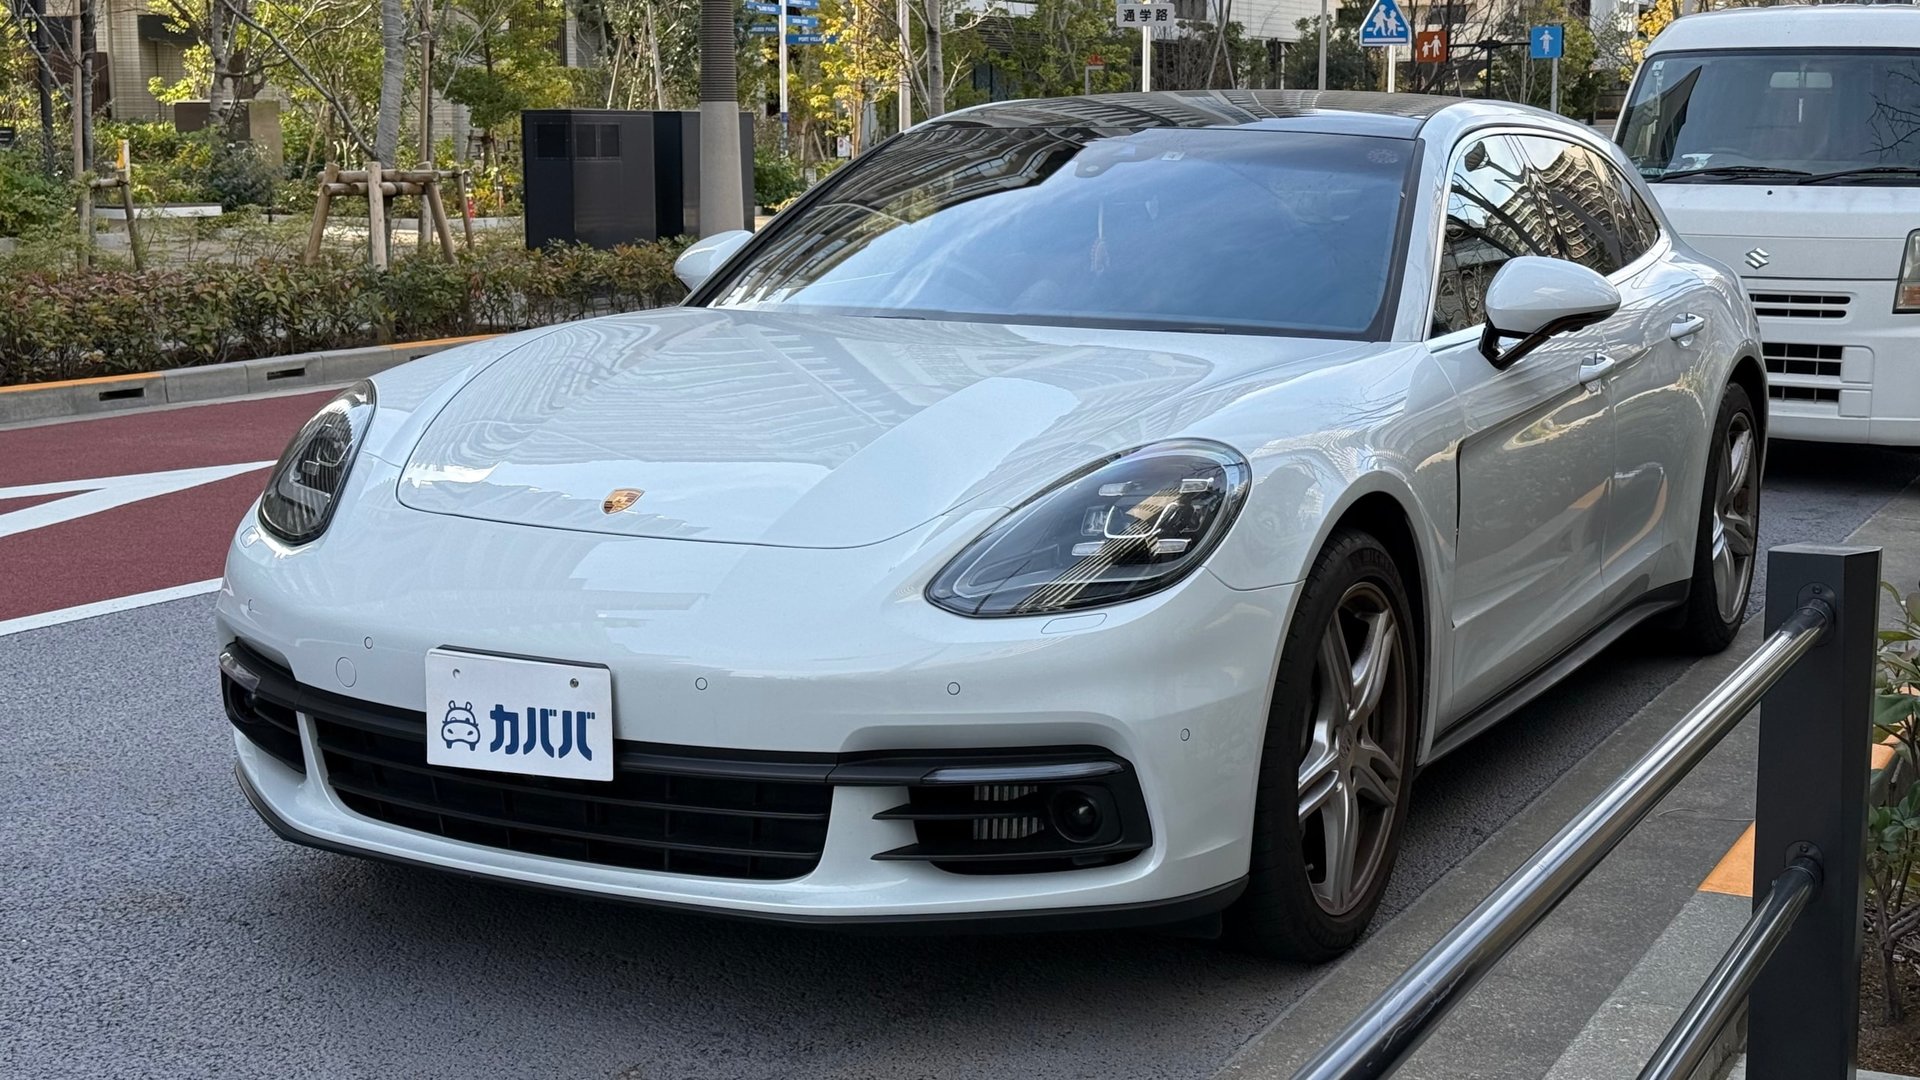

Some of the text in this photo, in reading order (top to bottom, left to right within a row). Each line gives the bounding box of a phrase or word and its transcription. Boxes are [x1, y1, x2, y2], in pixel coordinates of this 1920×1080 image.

[1123, 8, 1168, 22] 通学路
[489, 703, 596, 762] カババ
